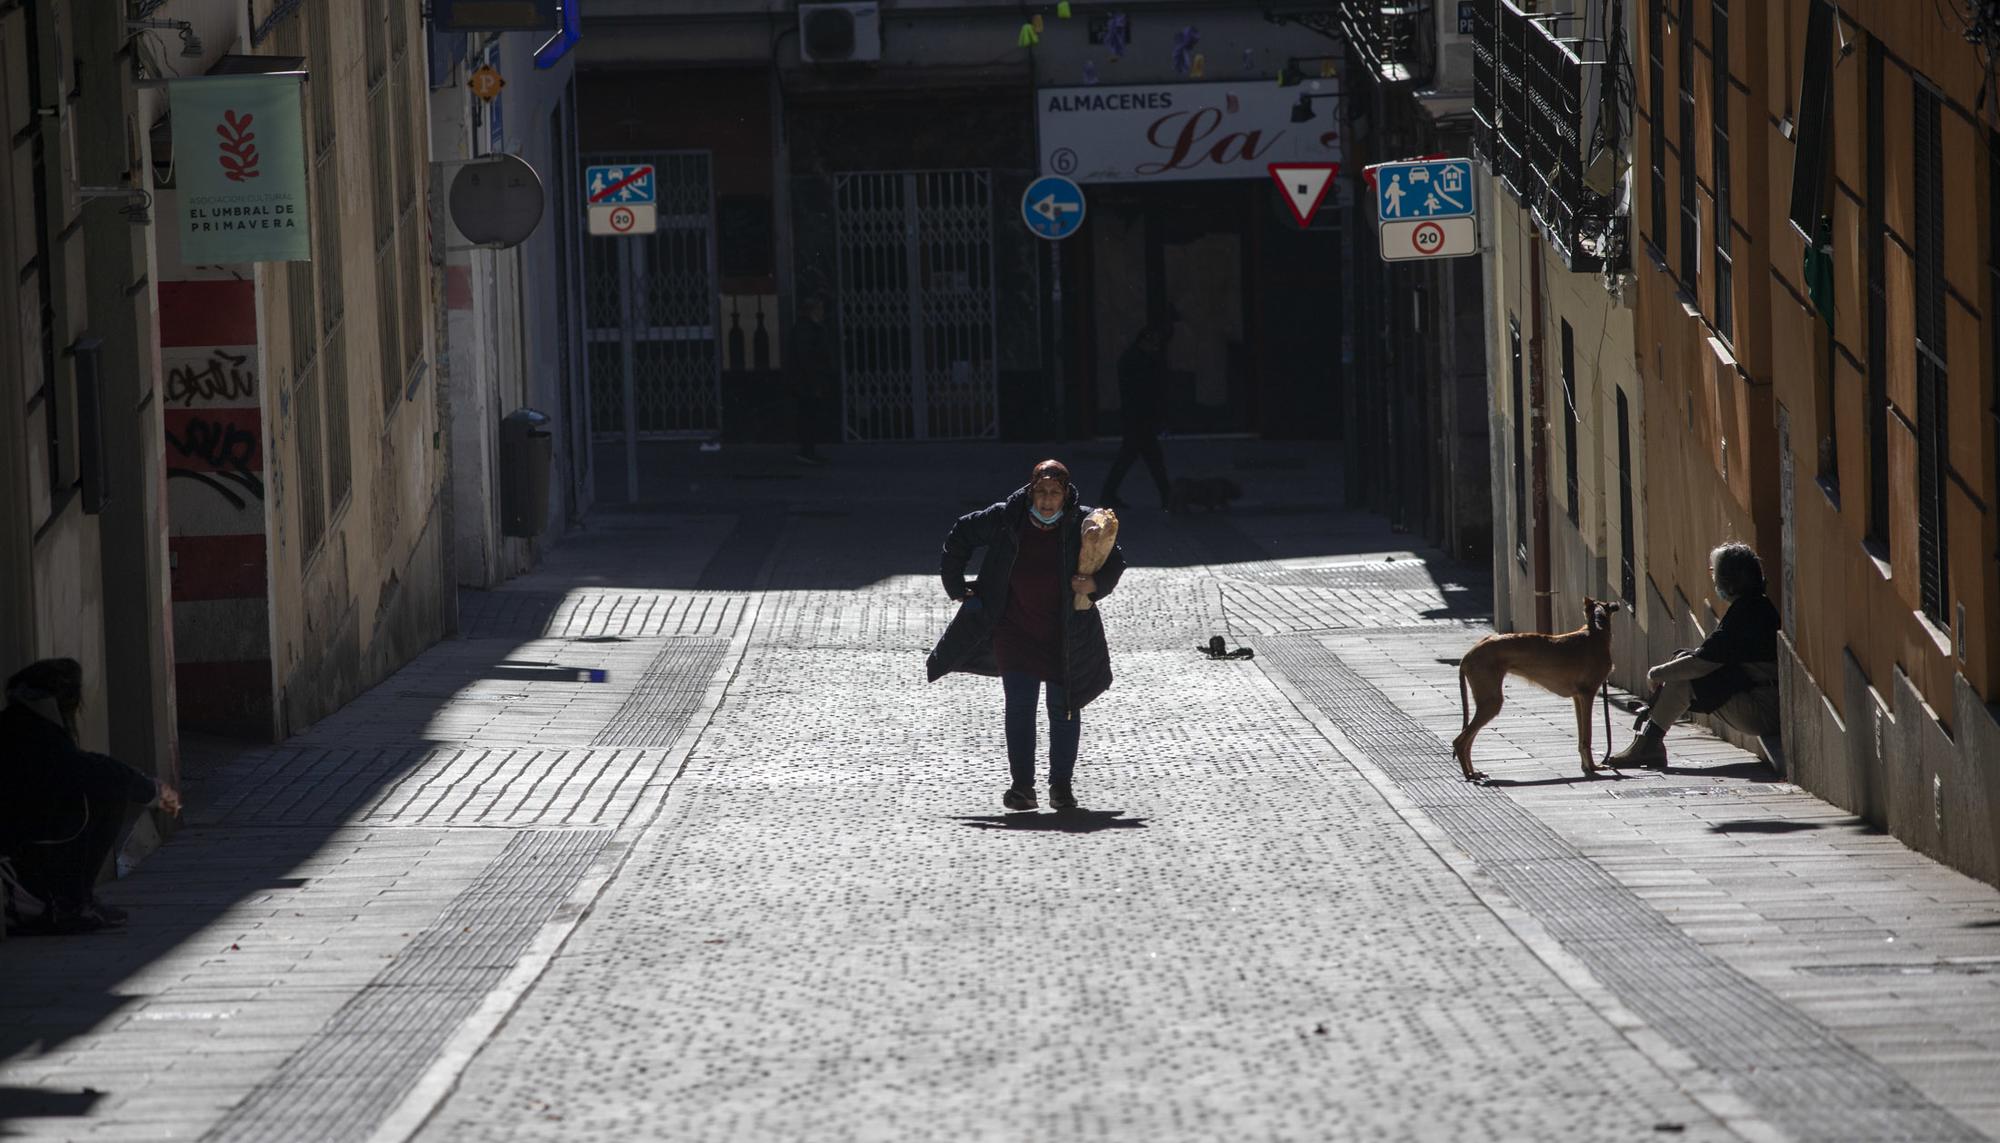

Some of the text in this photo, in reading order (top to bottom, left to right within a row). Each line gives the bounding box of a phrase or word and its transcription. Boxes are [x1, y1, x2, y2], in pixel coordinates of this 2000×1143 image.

[1049, 92, 1172, 112] ALMACENES
[1136, 107, 1286, 175] La
[1058, 152, 1071, 171] 6
[190, 204, 294, 218] EL UMBRAL DE
[191, 218, 295, 232] PRIMAVERA
[616, 215, 629, 224] 20
[1420, 232, 1437, 244] 20
